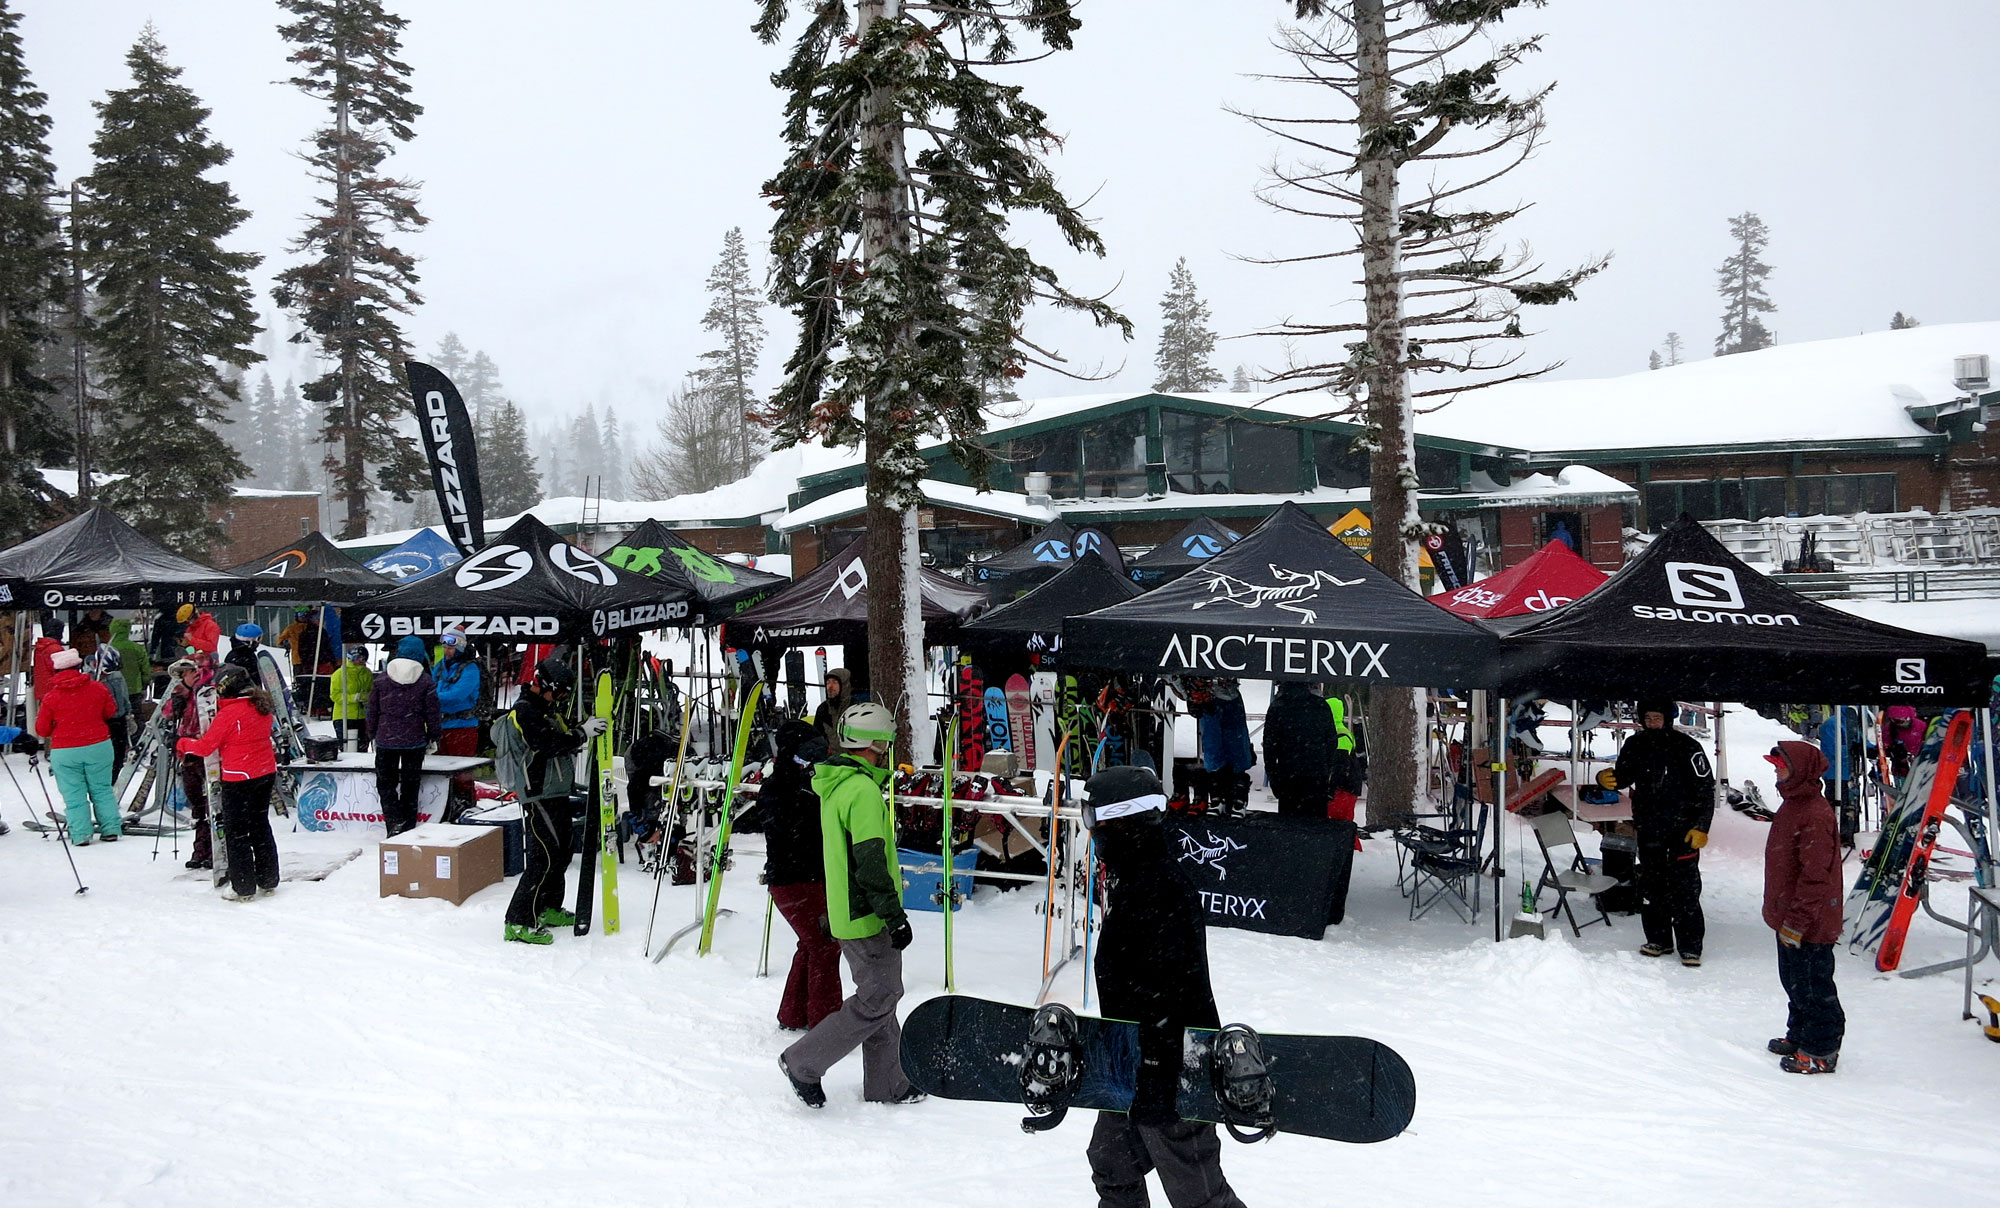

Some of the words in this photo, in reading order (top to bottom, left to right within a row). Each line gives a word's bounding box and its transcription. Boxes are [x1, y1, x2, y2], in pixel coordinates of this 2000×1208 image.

[425, 390, 476, 554] LIZZARD
[64, 594, 121, 602] SCARPA
[390, 616, 559, 636] BLIZZARD
[607, 600, 690, 630] BLIZZARD
[1158, 632, 1391, 678] ARC'TERYX
